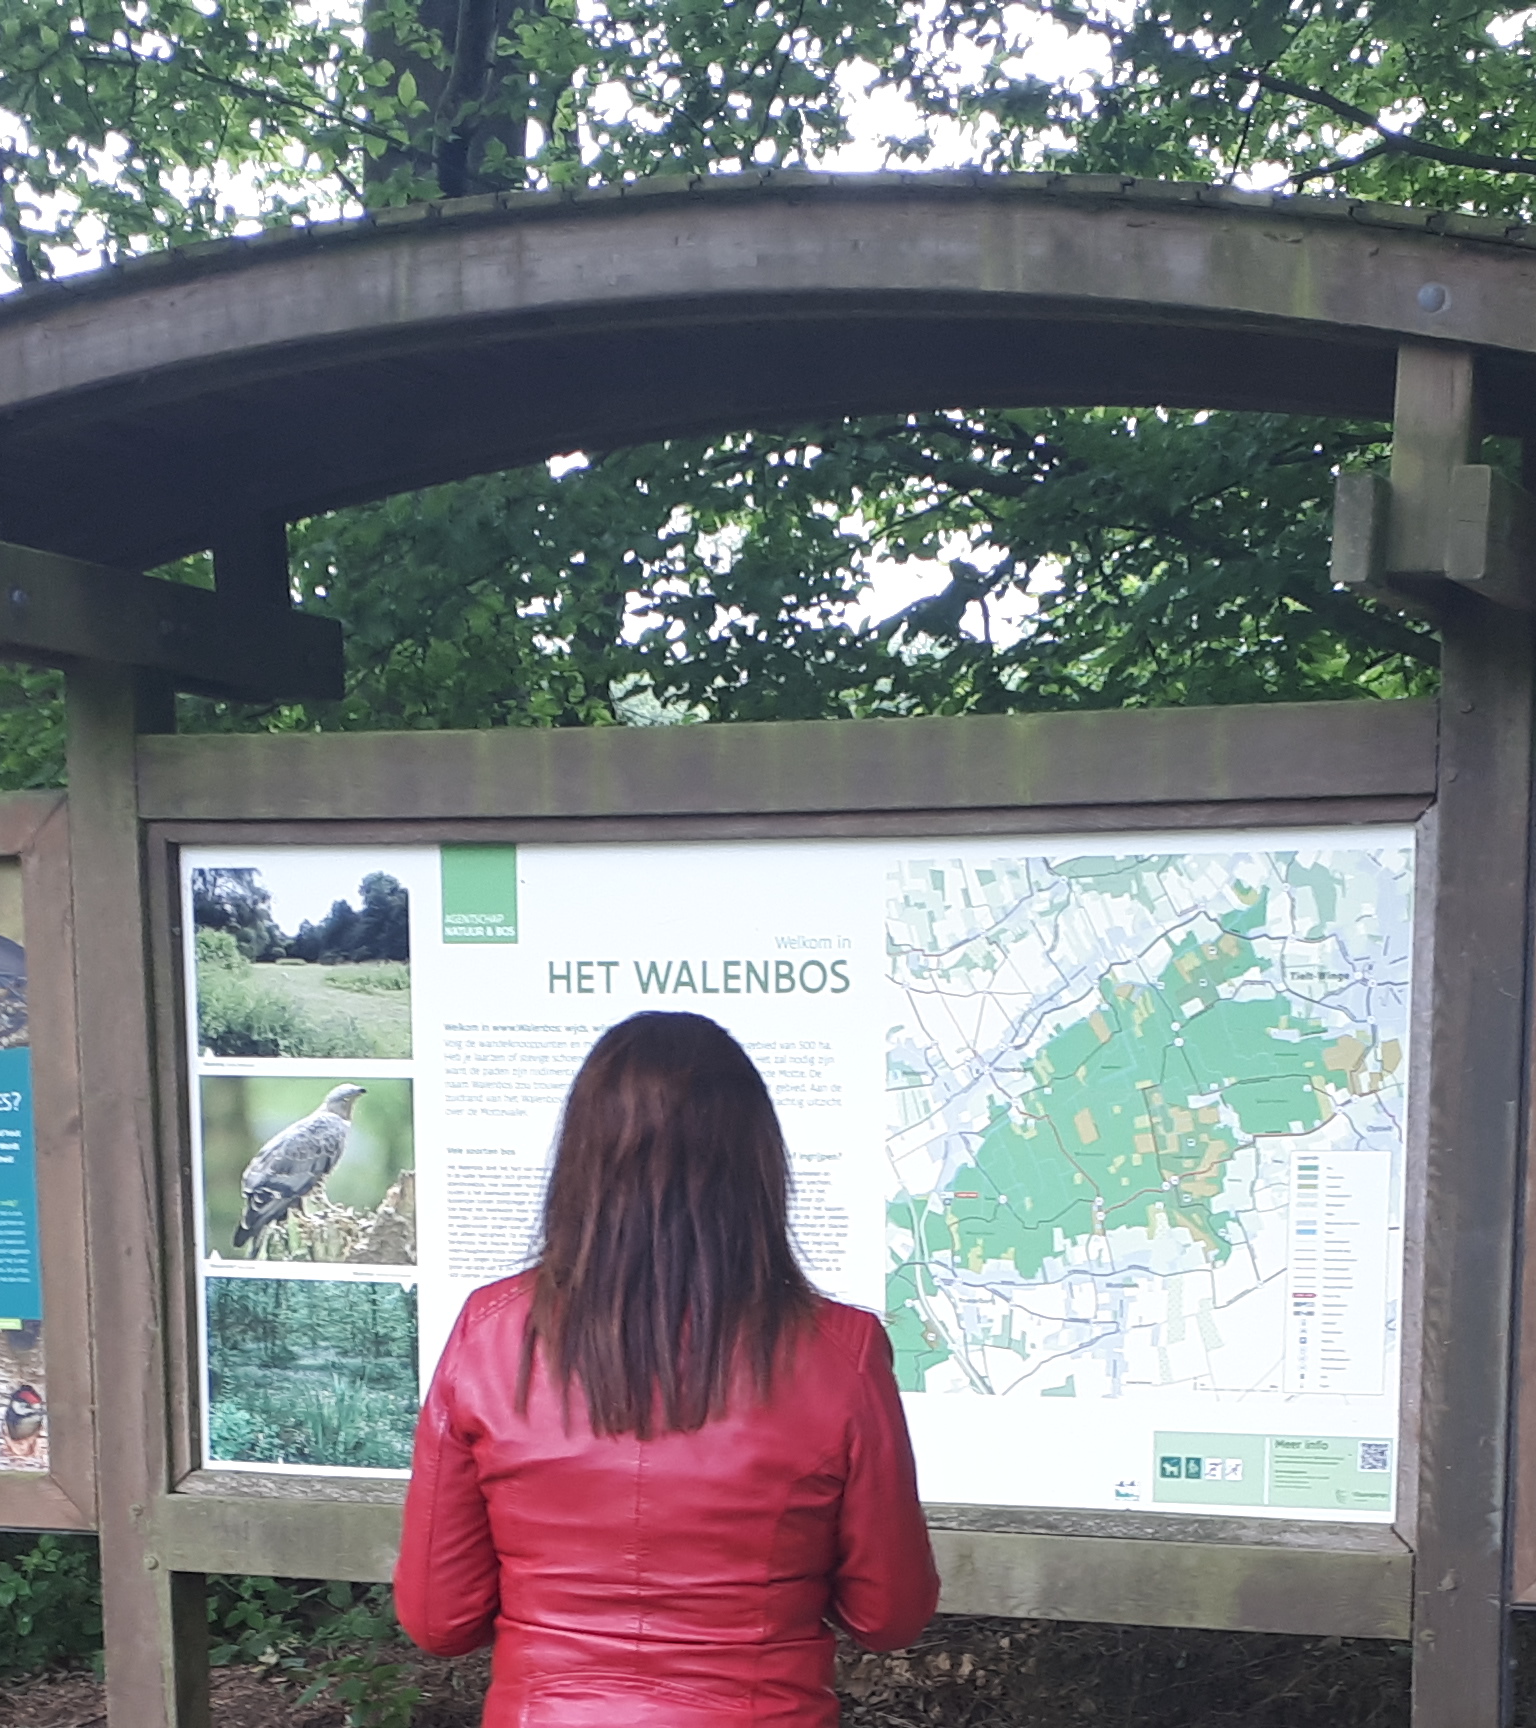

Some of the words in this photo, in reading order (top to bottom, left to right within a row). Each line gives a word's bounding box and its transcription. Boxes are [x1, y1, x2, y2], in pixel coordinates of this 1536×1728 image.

[444, 914, 505, 924] AGENTSCHAP
[444, 926, 484, 937] NATUUR
[486, 926, 494, 937] &
[496, 927, 516, 937] BOS
[775, 935, 832, 949] Welkom
[838, 935, 851, 949] in
[548, 960, 619, 994] HET
[633, 960, 850, 994] WALENBOS
[444, 1023, 479, 1032] Welkom
[1274, 1439, 1302, 1449] Meer
[1304, 1439, 1329, 1450] info
